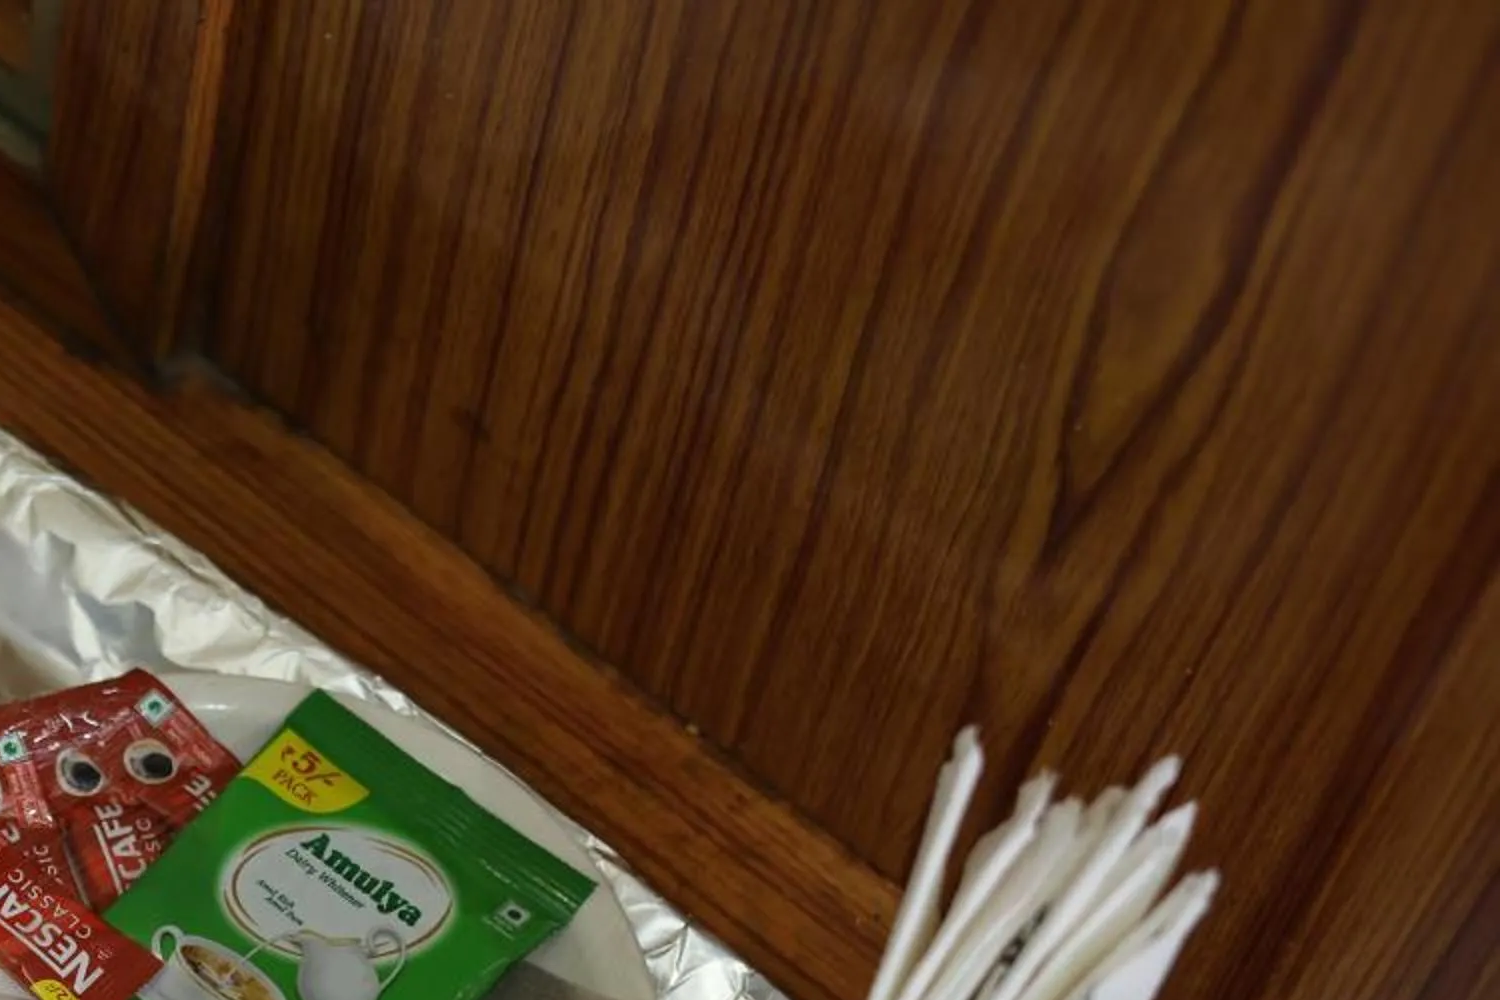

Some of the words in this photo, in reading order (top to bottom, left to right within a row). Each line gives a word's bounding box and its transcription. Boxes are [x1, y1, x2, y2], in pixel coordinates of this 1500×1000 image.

[271, 769, 319, 805] PACK
[7, 867, 93, 940] CLASSIC
[284, 848, 318, 881] Dairy
[319, 871, 368, 910] Whitener
[301, 832, 423, 927] Amulya
